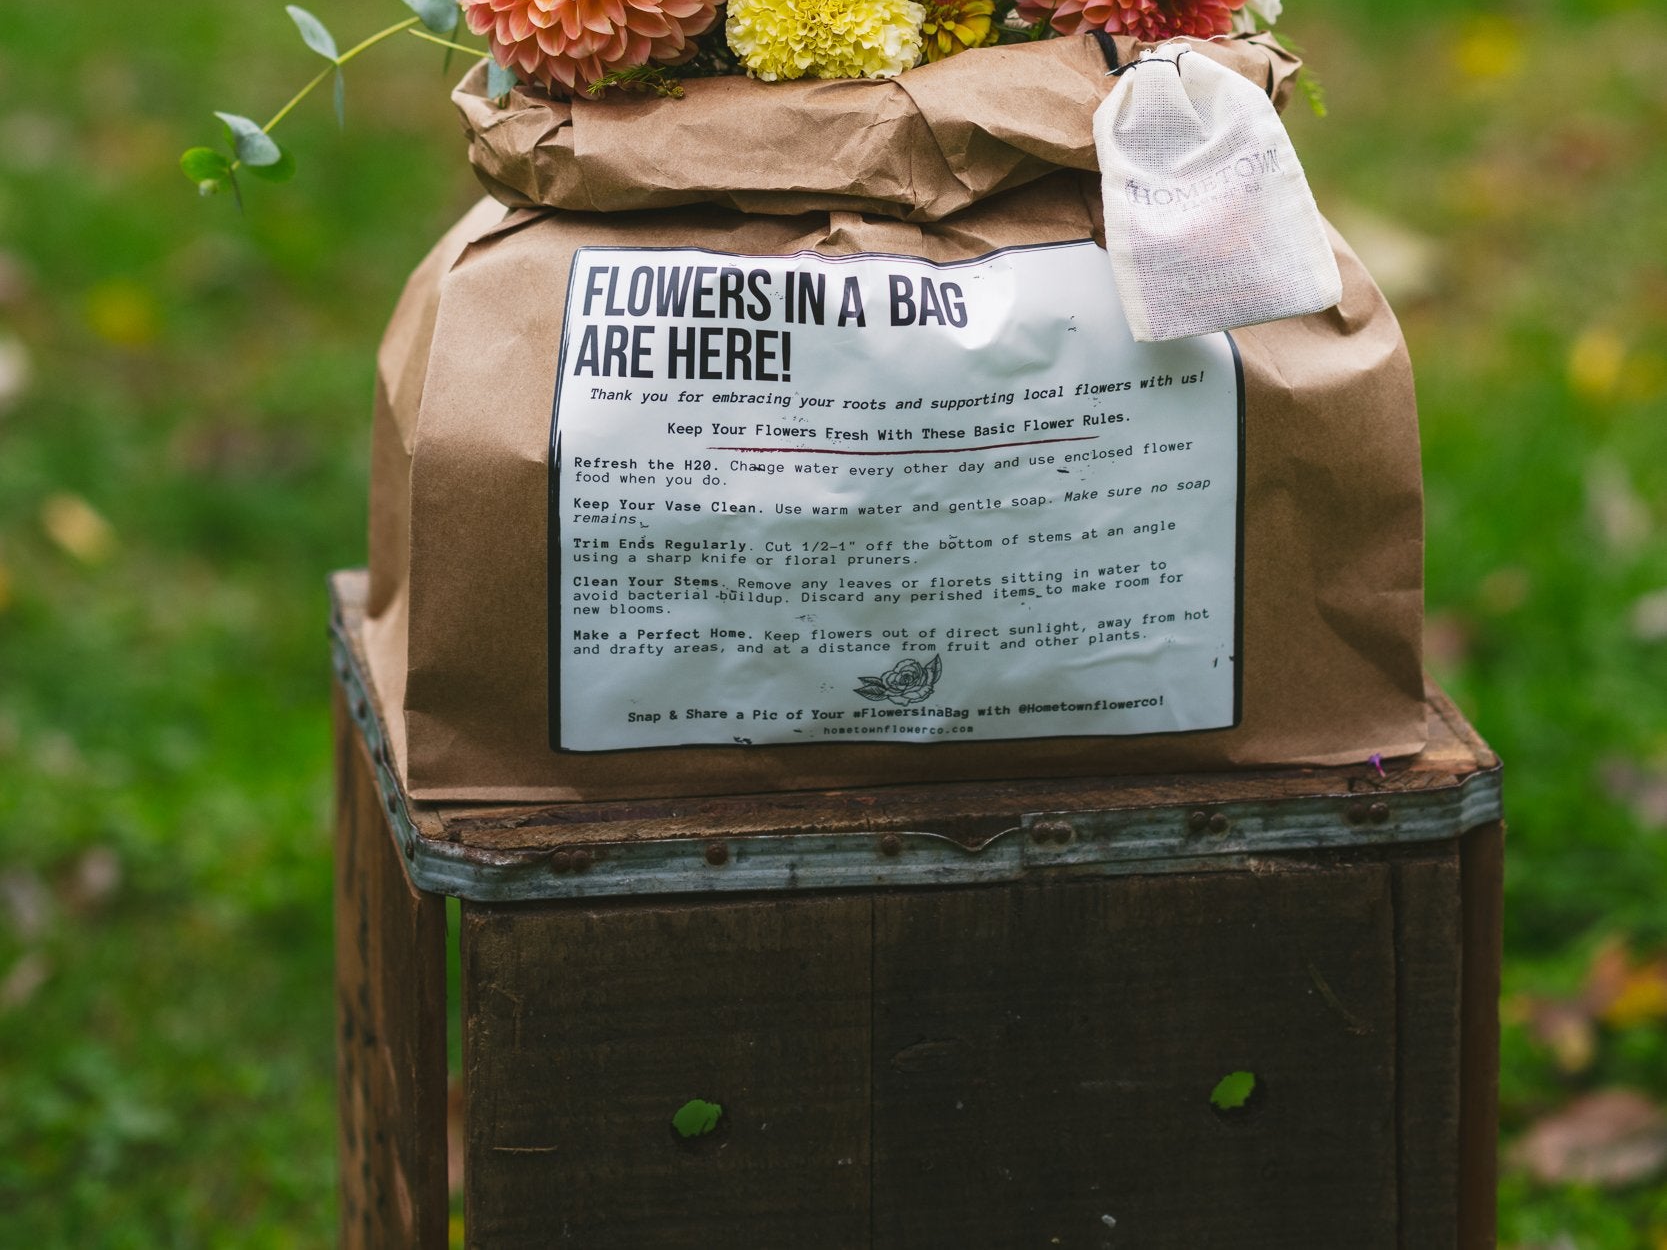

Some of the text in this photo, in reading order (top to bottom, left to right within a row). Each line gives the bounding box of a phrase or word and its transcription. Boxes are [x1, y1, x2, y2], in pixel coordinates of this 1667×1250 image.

[583, 265, 968, 329] FLOWERS IN A BAG
[574, 324, 792, 382] ARE HERE!
[590, 370, 1205, 411] Thank you for embracing your roots and supporting local flowers with us!
[667, 412, 1130, 441] Keep Your Flowers Fresh With These Basic Flower Rules.
[574, 457, 638, 470] Refresh
[648, 459, 675, 470] the
[730, 460, 785, 475] Change
[794, 462, 839, 475] water
[849, 466, 894, 478] every
[904, 463, 949, 474] other
[958, 461, 985, 474] day
[994, 457, 1020, 470] and
[1029, 455, 1055, 466] use
[1064, 445, 1133, 463] enclosed
[1143, 441, 1193, 455] flower
[575, 471, 727, 488] food when you do.
[573, 479, 1211, 515] Keep Your Vase Clean. Use warm water and gentle soap. Make sure no soap
[573, 538, 610, 549] Trim
[619, 536, 655, 549] Ends
[665, 539, 753, 552] Regularly.
[765, 541, 792, 552] Cut
[866, 540, 893, 551] off
[903, 539, 929, 550] the
[939, 538, 993, 550] bottom
[1001, 534, 1019, 546] of
[1028, 532, 1072, 543] stems
[1081, 528, 1098, 540] at
[1107, 527, 1124, 537] an
[1133, 521, 1176, 535] angle
[573, 552, 918, 567] using a sharp knife or floral pruners.
[573, 560, 1167, 591] Clean Your Stems. Remove any leaves or florets sitting in water to
[573, 572, 1184, 605] avoid bacterial buildup. Discard any perished items to make room for
[573, 604, 671, 615] new blooms.
[573, 608, 1210, 643] Make a Perfect Home. Keep flowers out of direct sunlight, away from hot
[573, 630, 1147, 657] and drafty areas, and at a distance from fruit and other plants.
[628, 695, 1164, 724] Snap & Share a Pic of Your #FlowersinaBag with @Hometownflowerco!
[824, 725, 974, 735] hometownflowerco.com
